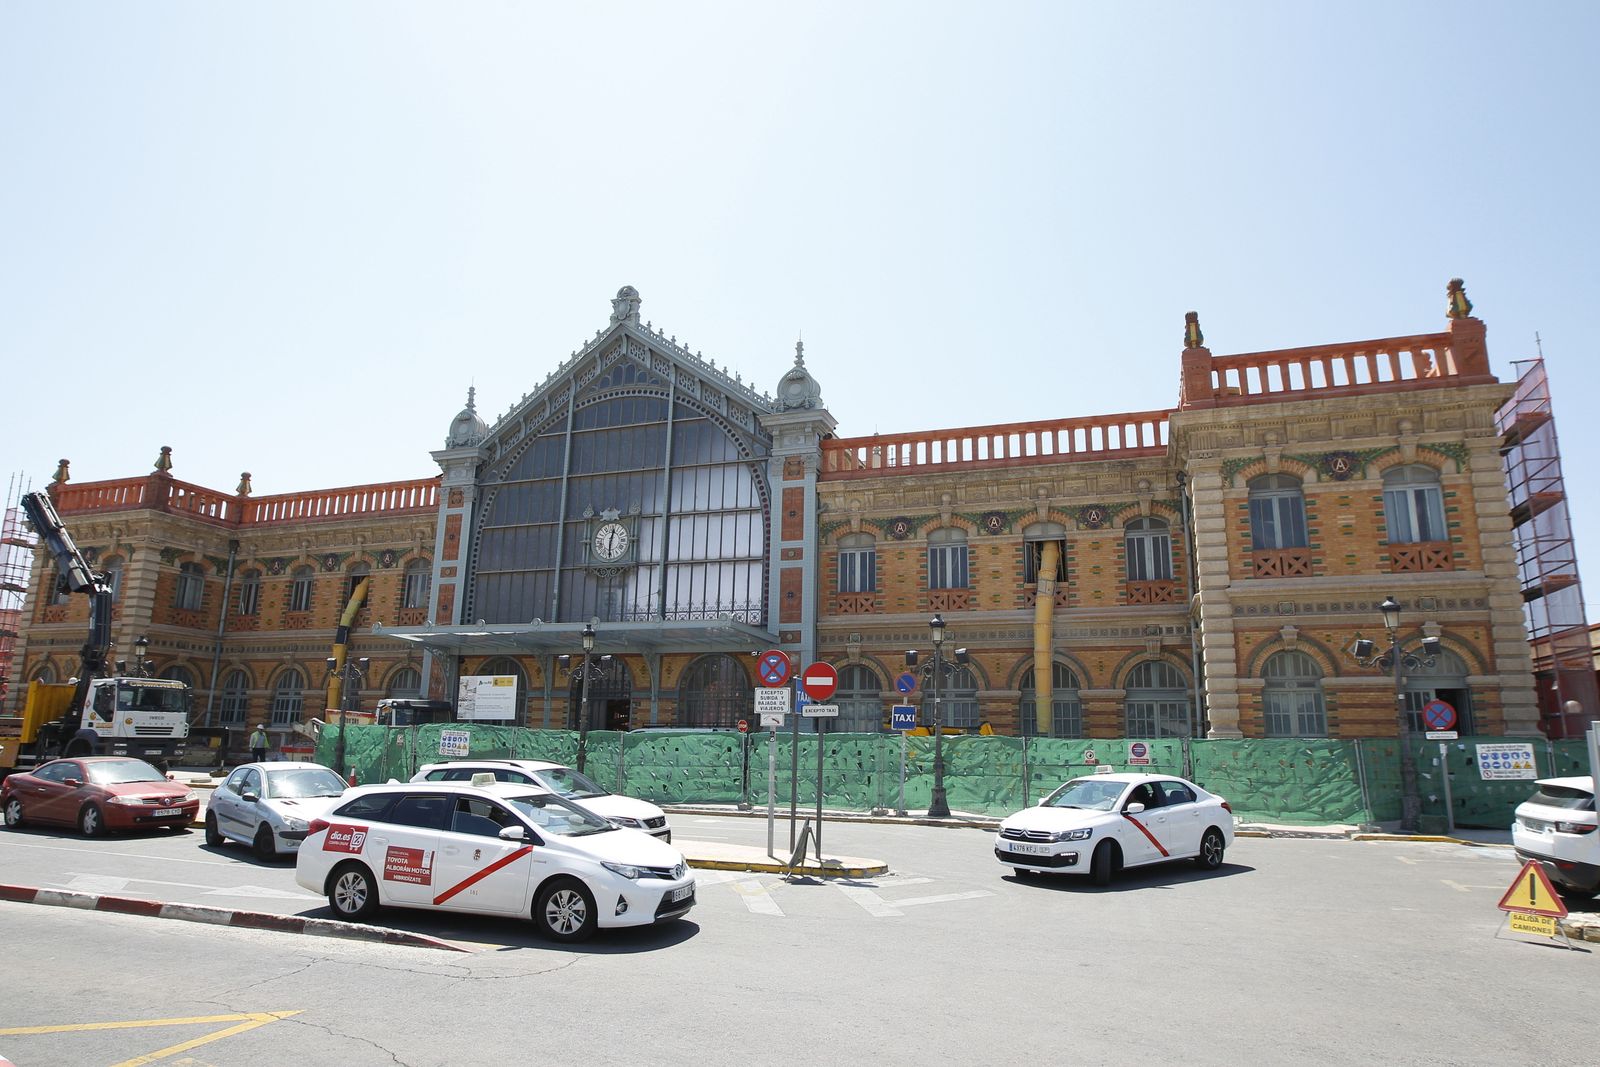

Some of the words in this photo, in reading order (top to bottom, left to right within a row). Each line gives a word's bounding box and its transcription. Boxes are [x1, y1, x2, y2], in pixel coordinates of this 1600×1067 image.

[894, 713, 915, 722] TAXI
[411, 867, 431, 875] MOTOR
[1513, 914, 1540, 923] SALIDA
[1512, 923, 1552, 934] CAMIONES
